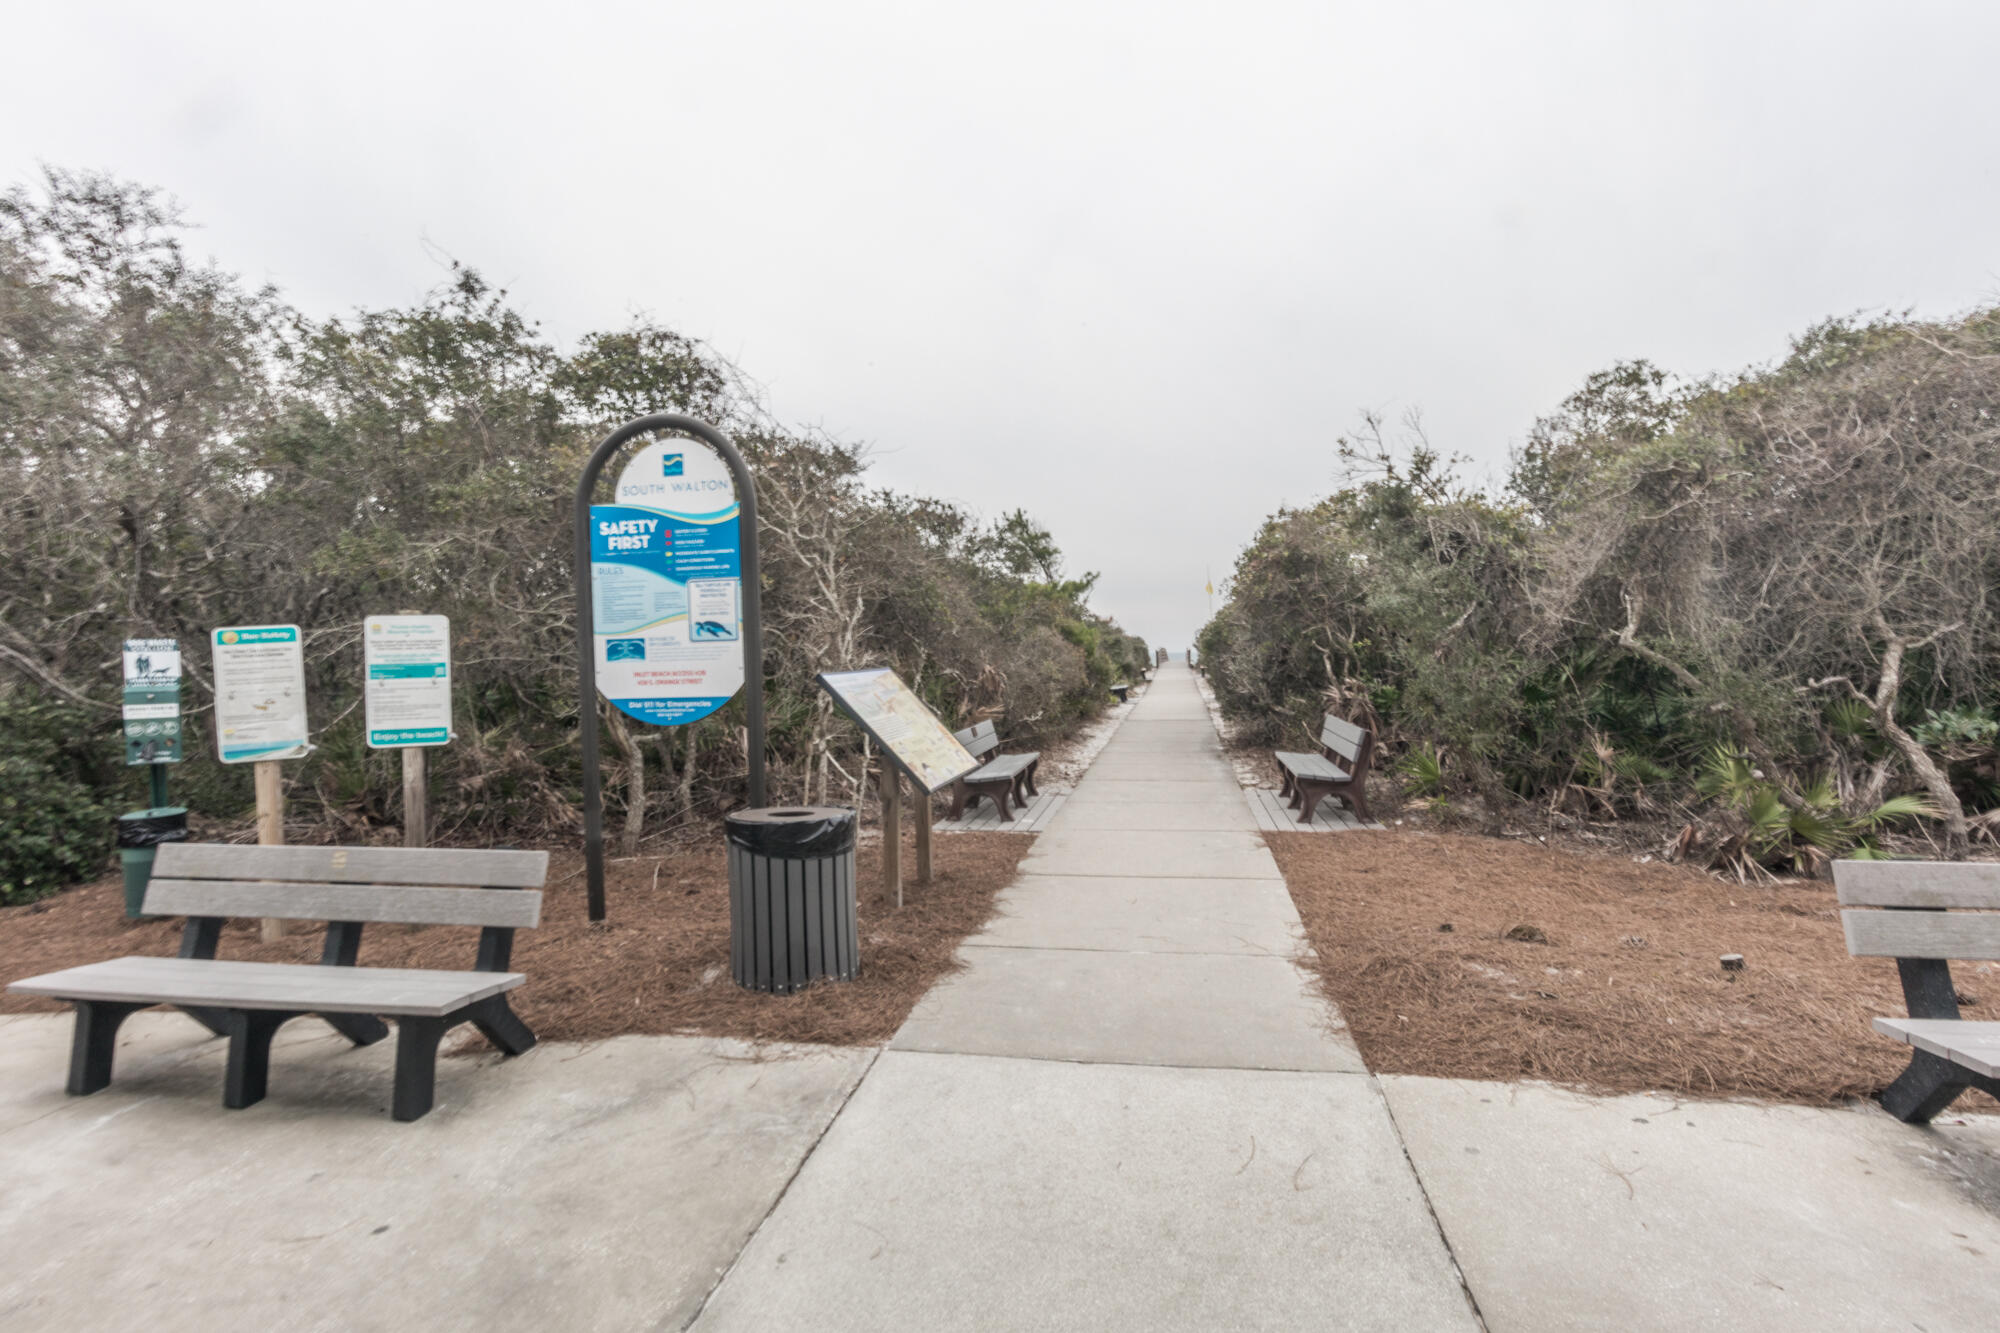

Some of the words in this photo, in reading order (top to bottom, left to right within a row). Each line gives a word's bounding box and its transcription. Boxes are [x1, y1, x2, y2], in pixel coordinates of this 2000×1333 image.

[622, 484, 664, 496] SOUTH
[672, 479, 729, 492] WALTON
[599, 519, 659, 536] SAFETY
[608, 535, 651, 551] FIRST
[373, 732, 400, 742] Enjoy
